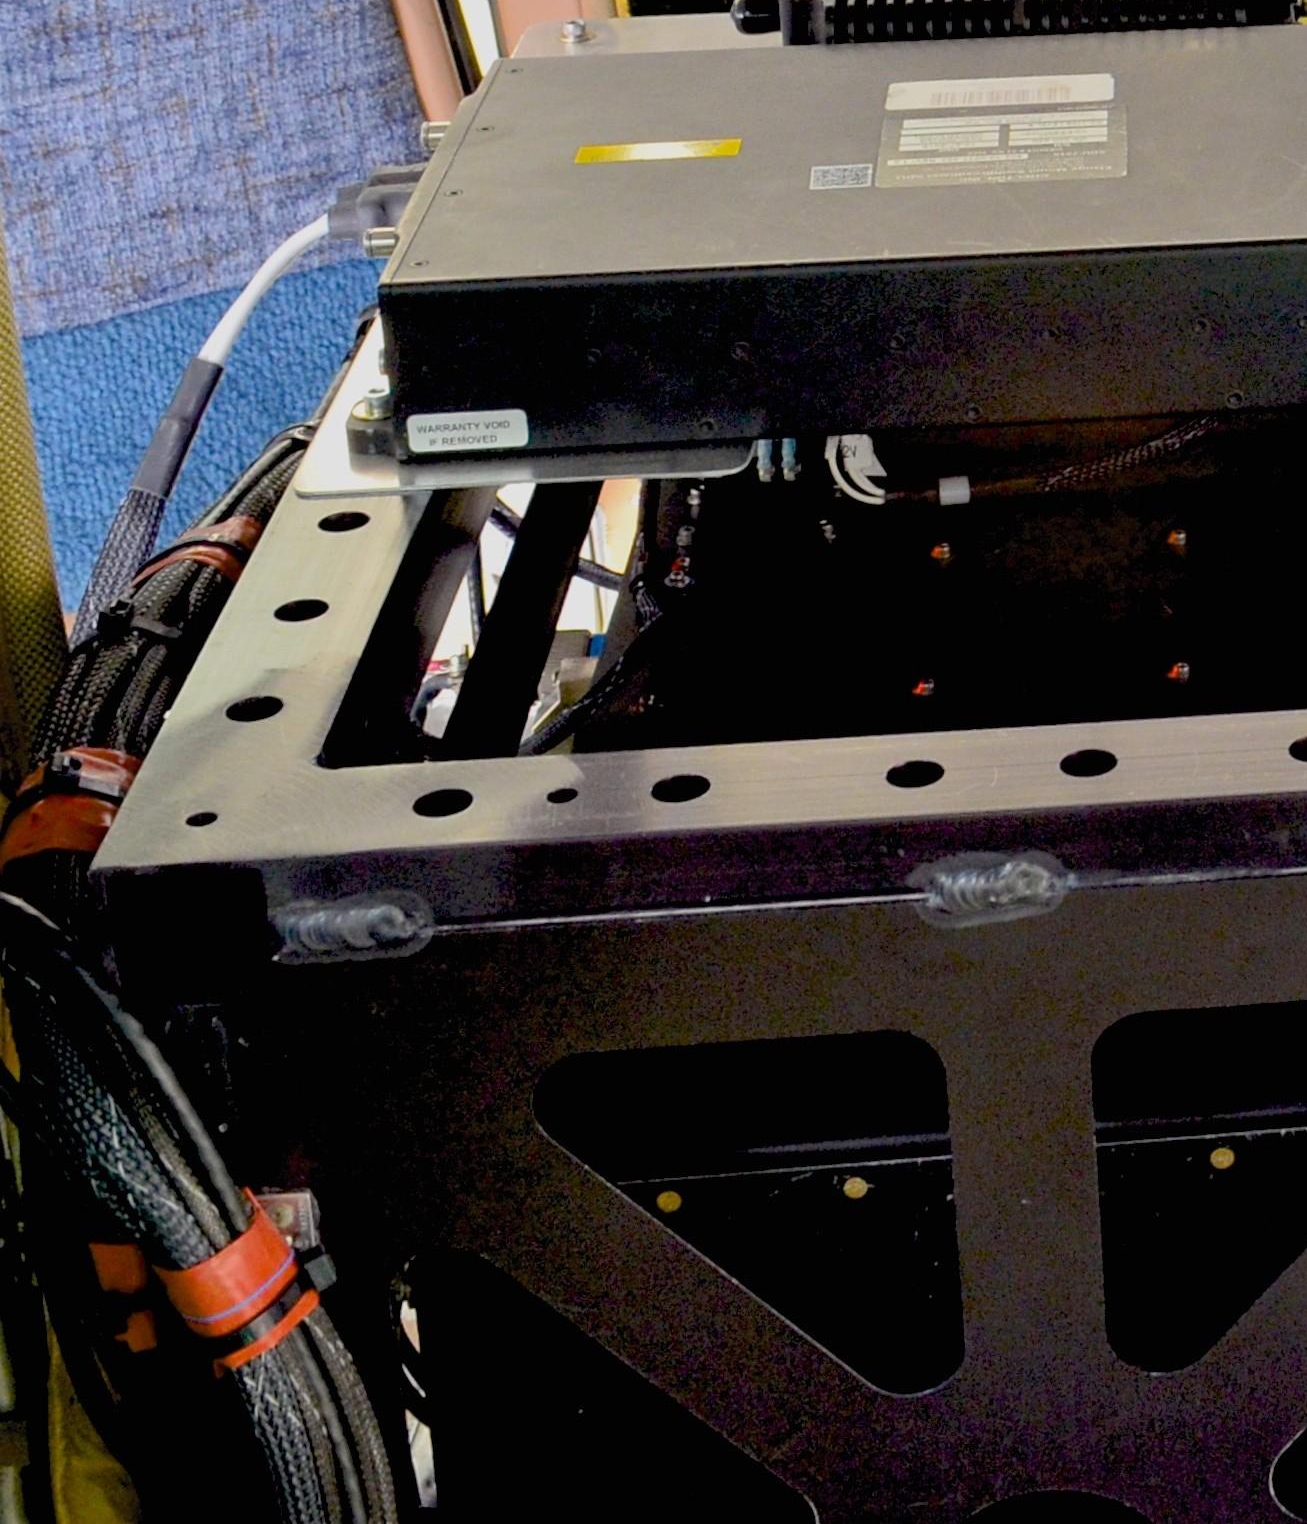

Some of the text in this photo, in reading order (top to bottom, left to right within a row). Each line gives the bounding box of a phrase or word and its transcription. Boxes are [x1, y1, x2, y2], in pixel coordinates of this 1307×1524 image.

[416, 420, 511, 434] WARRANTY VOID
[429, 434, 498, 446] IF REMOVED
